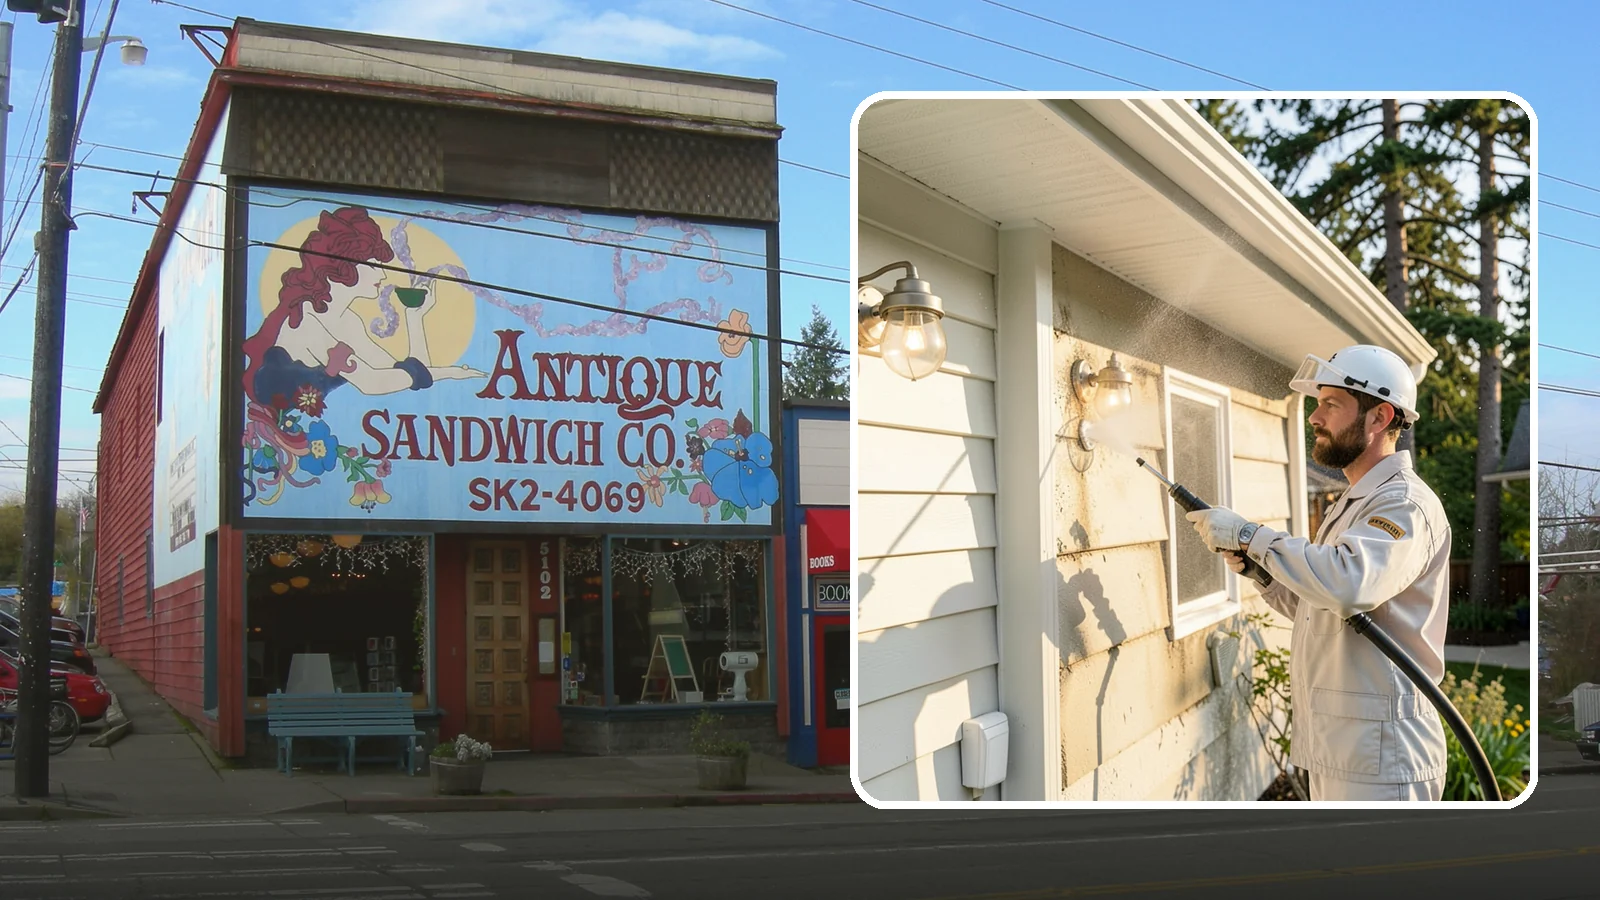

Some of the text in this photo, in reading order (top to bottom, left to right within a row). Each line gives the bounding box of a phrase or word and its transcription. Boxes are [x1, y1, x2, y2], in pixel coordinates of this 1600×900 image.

[475, 328, 723, 421] ANTIQUE
[361, 408, 685, 469] SANDWICH CO.
[468, 477, 646, 513] SK2-4069
[539, 541, 552, 600] 5102
[809, 554, 835, 569] BOOKS
